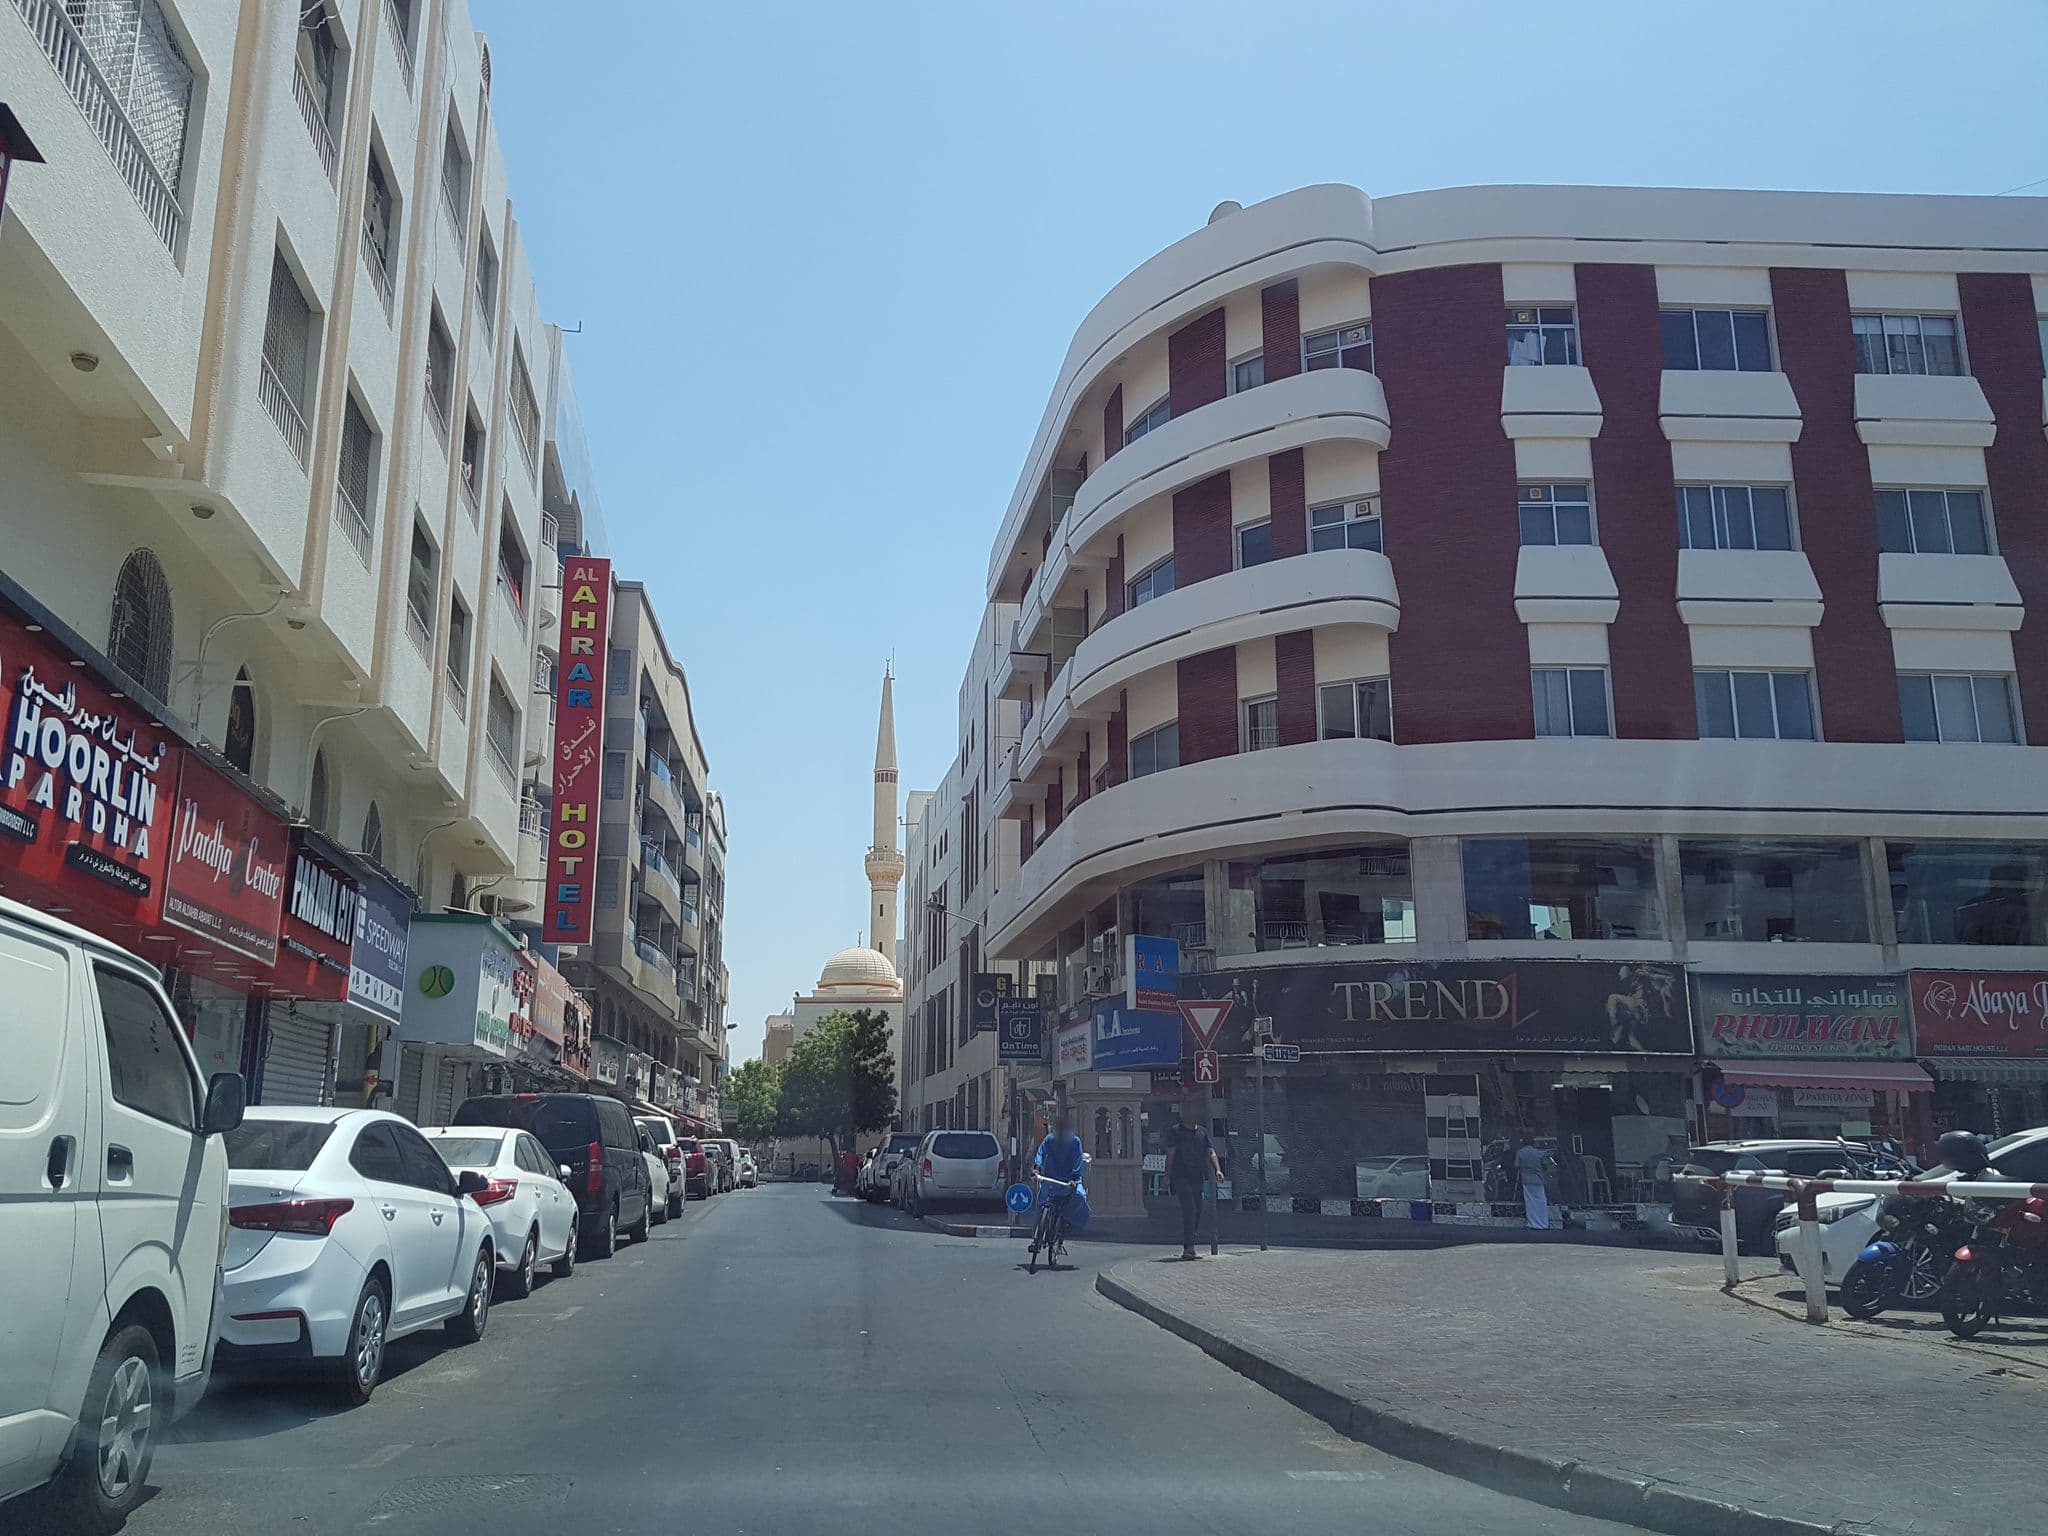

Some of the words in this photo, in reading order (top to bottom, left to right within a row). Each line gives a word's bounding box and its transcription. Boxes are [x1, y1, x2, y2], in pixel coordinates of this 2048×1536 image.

[572, 567, 599, 581] AL
[567, 585, 598, 709] AHRAR
[14, 695, 157, 828] HOORLIN
[562, 716, 597, 762] فندق
[8, 753, 149, 860] PARDHA
[176, 798, 233, 883] Pardha
[245, 836, 280, 900] Centre
[556, 803, 587, 930] HOTEL
[336, 883, 358, 945] CIT
[366, 918, 406, 963] SPEEDWAY
[1731, 987, 1801, 1008] للتجارة
[1960, 979, 2030, 1031] Abaya
[1712, 1014, 1899, 1042] PHULWANI
